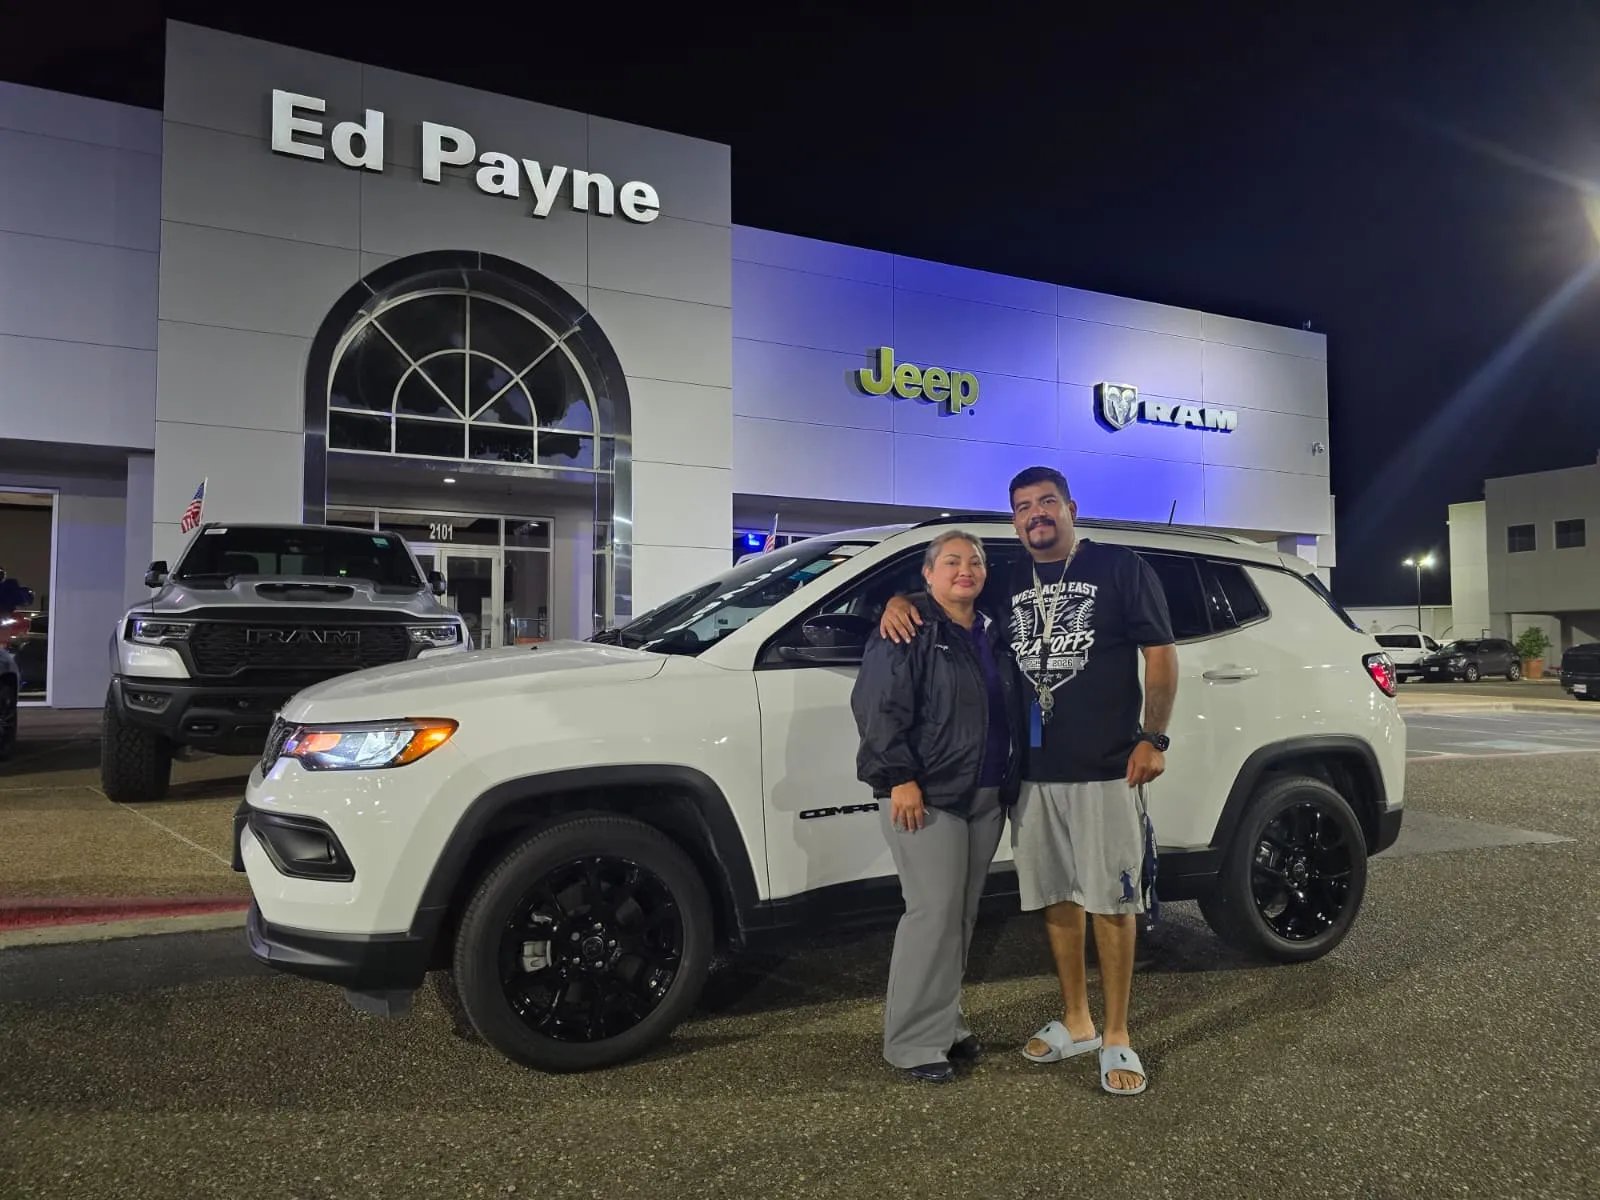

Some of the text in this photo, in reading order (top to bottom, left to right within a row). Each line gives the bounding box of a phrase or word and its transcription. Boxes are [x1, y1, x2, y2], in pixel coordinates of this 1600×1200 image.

[271, 88, 660, 223] Ed Payne
[859, 346, 980, 414] Jeep
[1142, 400, 1238, 432] RAM
[429, 523, 454, 540] 2101
[1012, 581, 1097, 606] WESACO EAST
[246, 628, 361, 644] RAM
[1010, 629, 1095, 656] PLAOFFS
[1052, 658, 1073, 668] 2026
